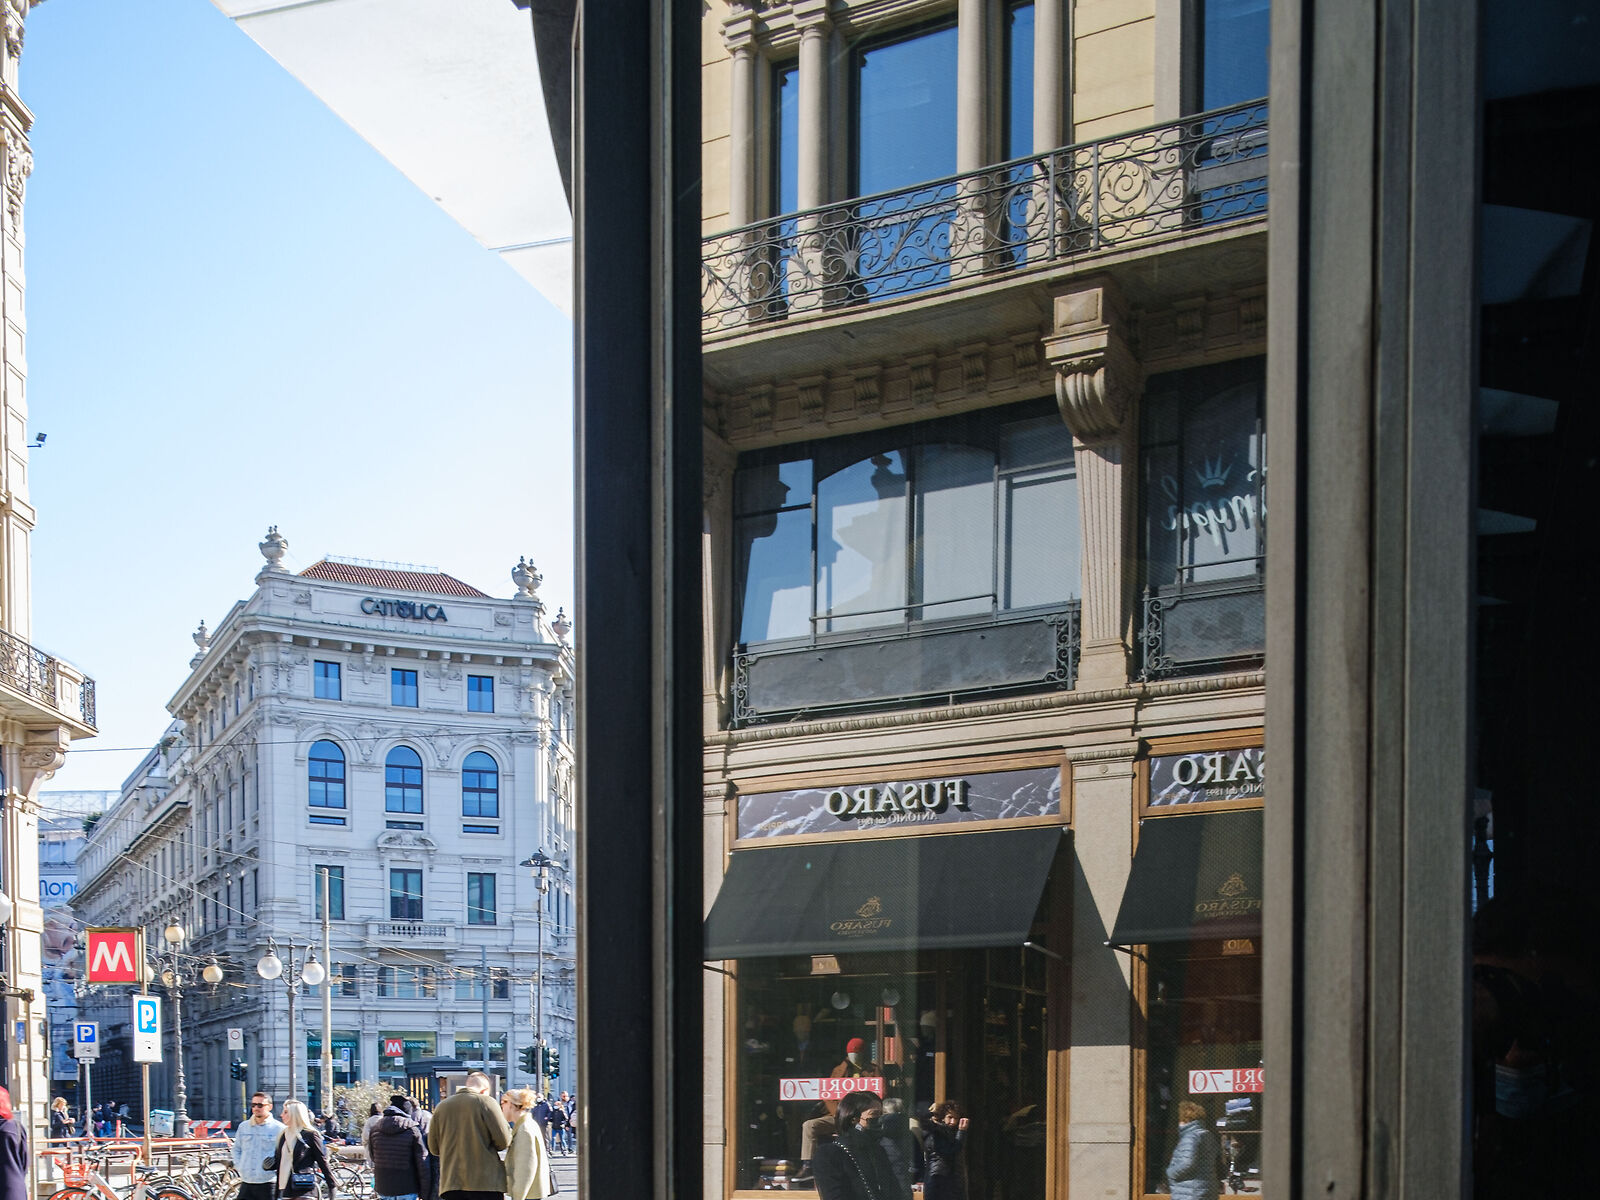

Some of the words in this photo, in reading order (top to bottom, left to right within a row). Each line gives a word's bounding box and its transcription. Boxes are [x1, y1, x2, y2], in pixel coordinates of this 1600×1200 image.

[91, 941, 134, 972] M
[141, 1004, 155, 1030] P
[80, 1026, 93, 1041] P
[386, 1042, 401, 1053] M
